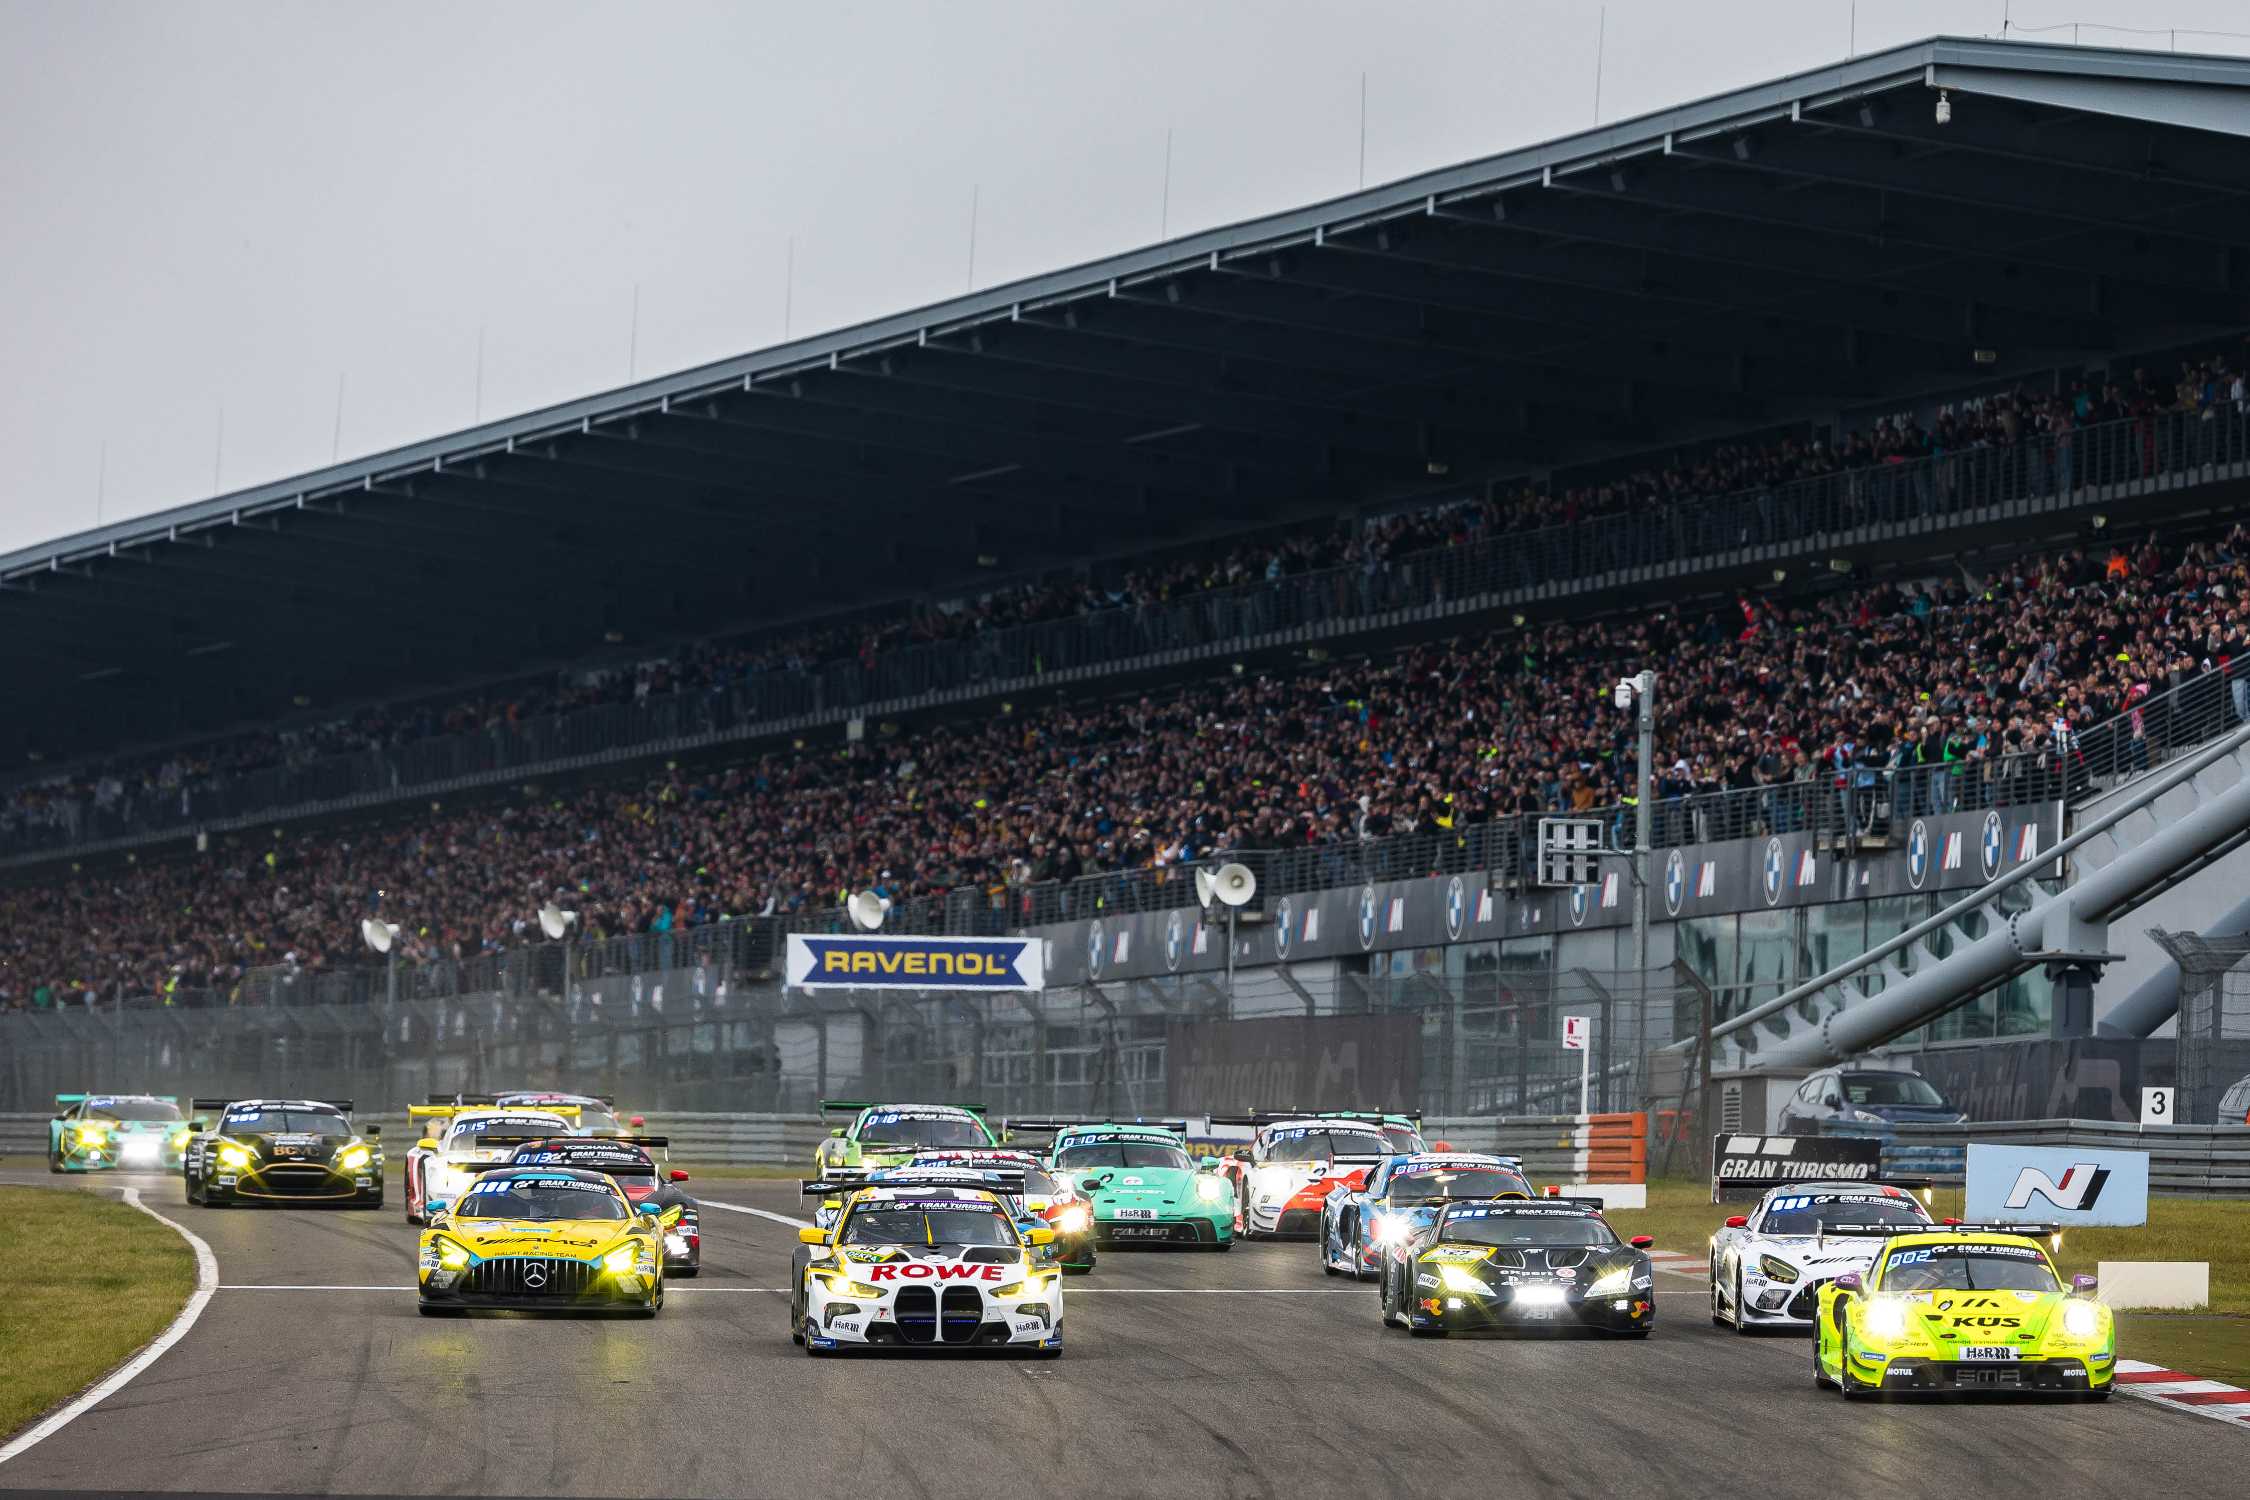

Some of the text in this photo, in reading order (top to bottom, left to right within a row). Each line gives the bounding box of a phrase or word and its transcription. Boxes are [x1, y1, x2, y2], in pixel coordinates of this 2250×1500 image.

[824, 951, 1007, 976] RAVENOL
[2151, 1091, 2166, 1116] 3
[1118, 1133, 1178, 1146] GRAN TURISMO
[1352, 1129, 1385, 1141] TURISMO
[596, 1151, 634, 1160] TURISMO
[1477, 1163, 1514, 1173] TURISMO
[1719, 1159, 1868, 1179] GRAN TURISMO
[538, 1180, 608, 1192] GRAN TURISMO
[949, 1203, 994, 1211] TURISMO
[1839, 1195, 1909, 1208] GRAN TURISMO
[1120, 1209, 1140, 1218] H&R
[1112, 1228, 1169, 1237] FALKEN
[1835, 1223, 2041, 1233] PORSCHE
[1957, 1244, 2037, 1257] GRAN TURISMO
[1889, 1250, 1932, 1267] 002
[870, 1264, 1005, 1282] ROWE
[1952, 1316, 2021, 1328] KÜS
[1966, 1346, 1995, 1360] H&R
[1886, 1367, 1914, 1377] MOTUL
[2063, 1368, 2087, 1377] MOTUL
